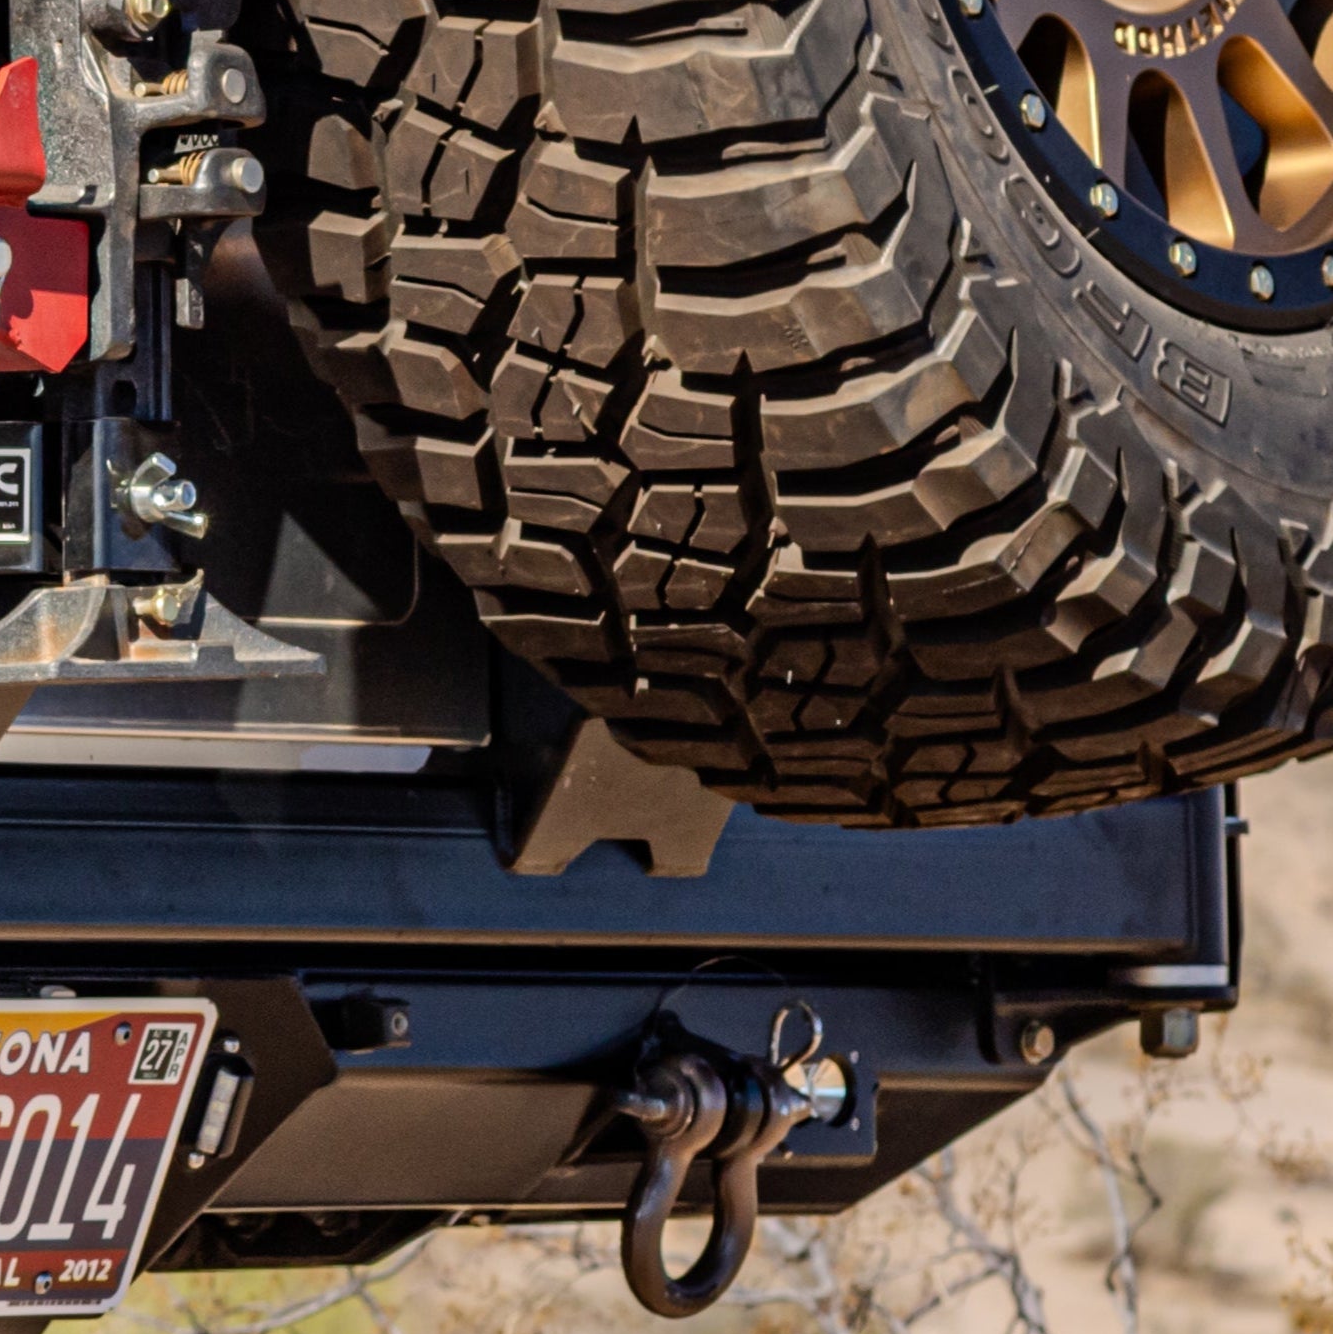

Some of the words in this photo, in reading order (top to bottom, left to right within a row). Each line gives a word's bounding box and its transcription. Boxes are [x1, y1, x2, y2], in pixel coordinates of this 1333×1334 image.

[140, 1039, 173, 1071] 27
[167, 1032, 188, 1078] APR
[58, 1259, 113, 1285] 2012
